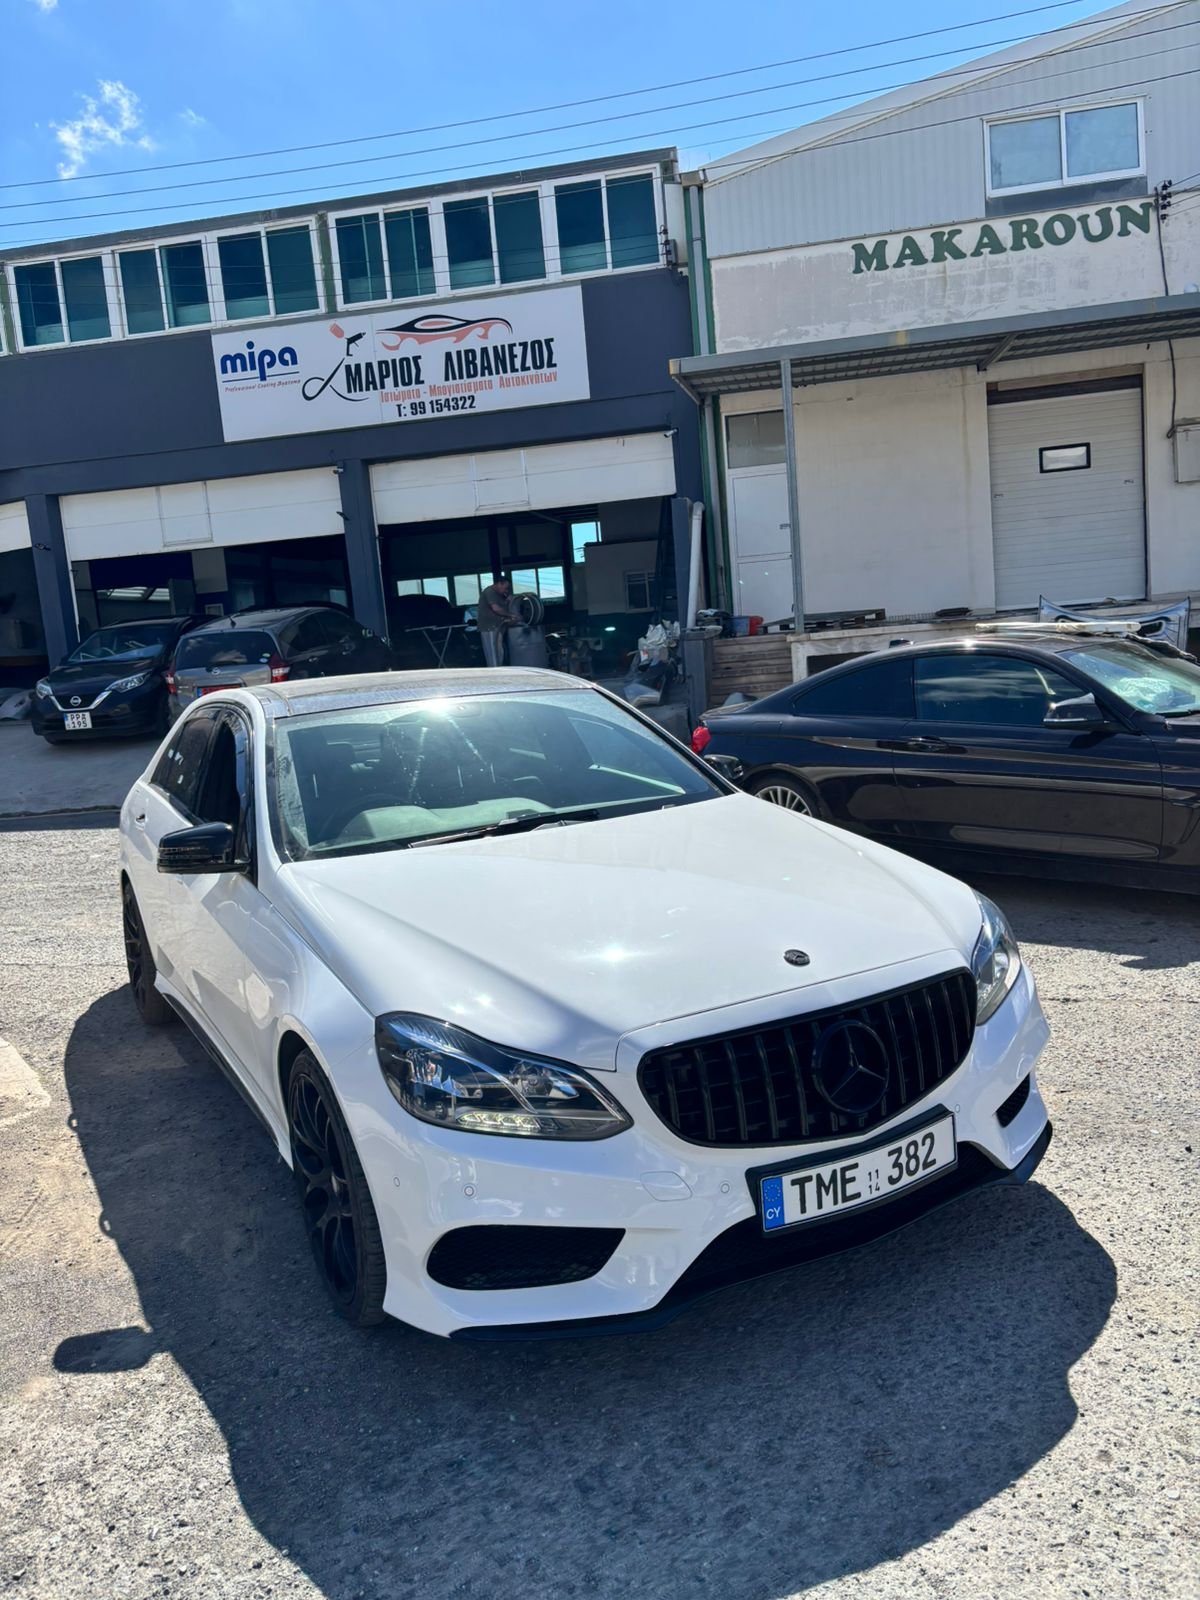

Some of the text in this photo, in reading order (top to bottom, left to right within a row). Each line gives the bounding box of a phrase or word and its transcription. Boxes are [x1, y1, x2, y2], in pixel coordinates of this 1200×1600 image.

[852, 202, 1154, 275] MAKAROUN
[220, 340, 298, 382] mipa
[345, 338, 557, 393] ΜΑΡΙΟΣ ΛΙΒΑΝΕΖΟΣ
[410, 401, 426, 415] 99
[429, 395, 476, 413] 154322
[790, 1132, 937, 1214] TME 382
[868, 1169, 879, 1183] 11
[868, 1183, 880, 1195] 14
[766, 1206, 781, 1220] CY
